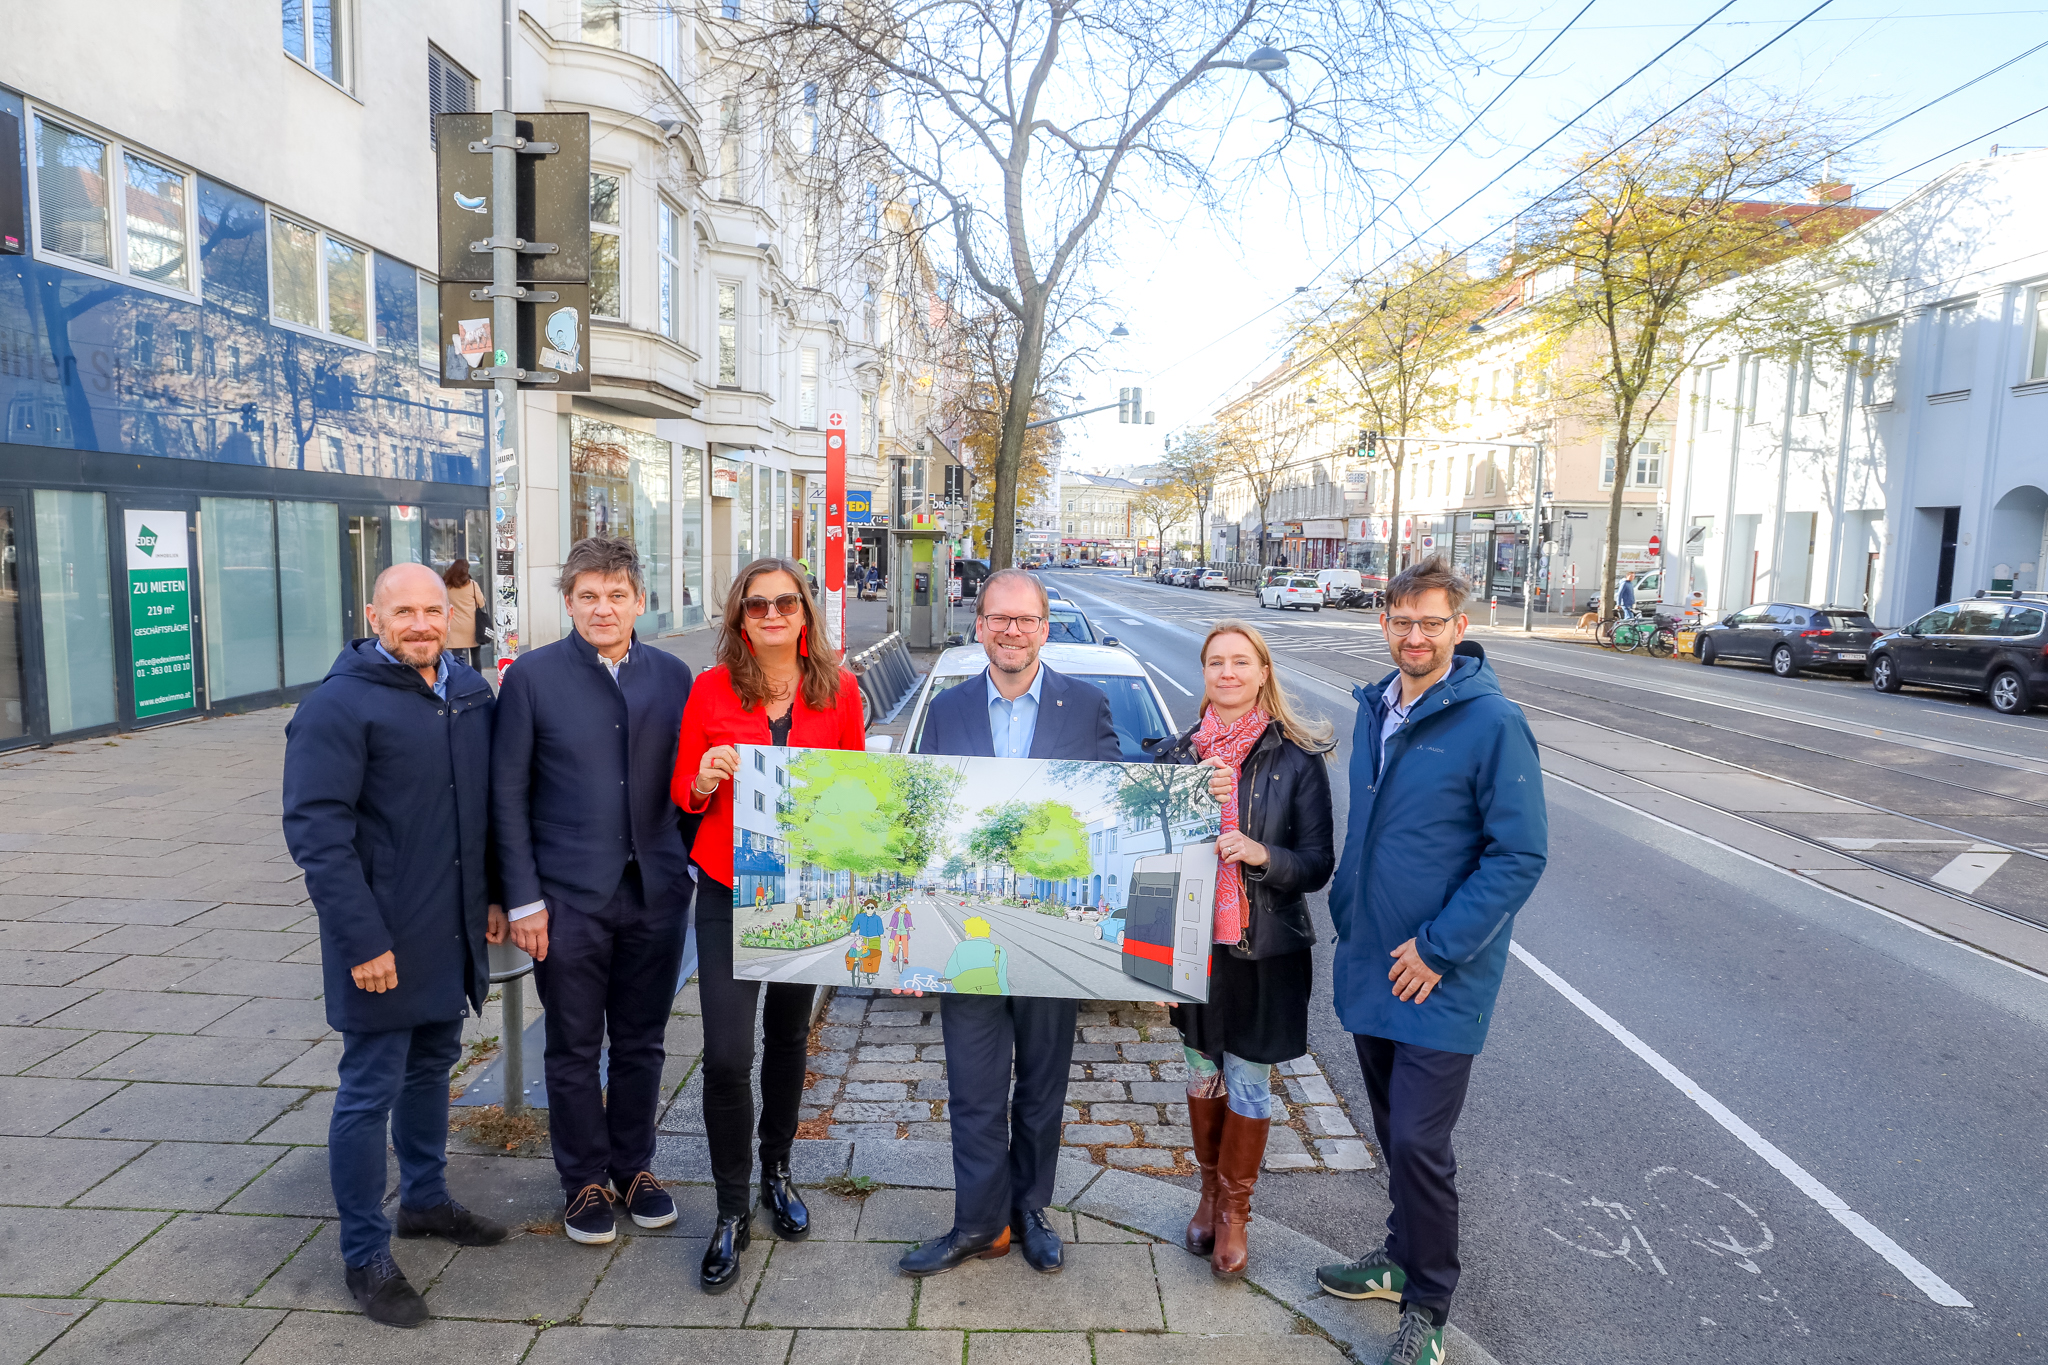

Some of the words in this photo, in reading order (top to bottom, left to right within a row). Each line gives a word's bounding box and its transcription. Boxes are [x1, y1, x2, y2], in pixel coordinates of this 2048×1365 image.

[137, 536, 156, 546] EDEX
[133, 582, 148, 594] ZU
[150, 580, 186, 593] MIETEN
[147, 606, 162, 616] 219
[134, 624, 188, 636] GESCHÄFTSFLÄCHE
[135, 654, 190, 667] office@edeximmo.at
[151, 666, 163, 675] 363
[164, 665, 172, 673] 01
[173, 664, 181, 672] 03
[139, 692, 191, 706] www.edeximmo.at
